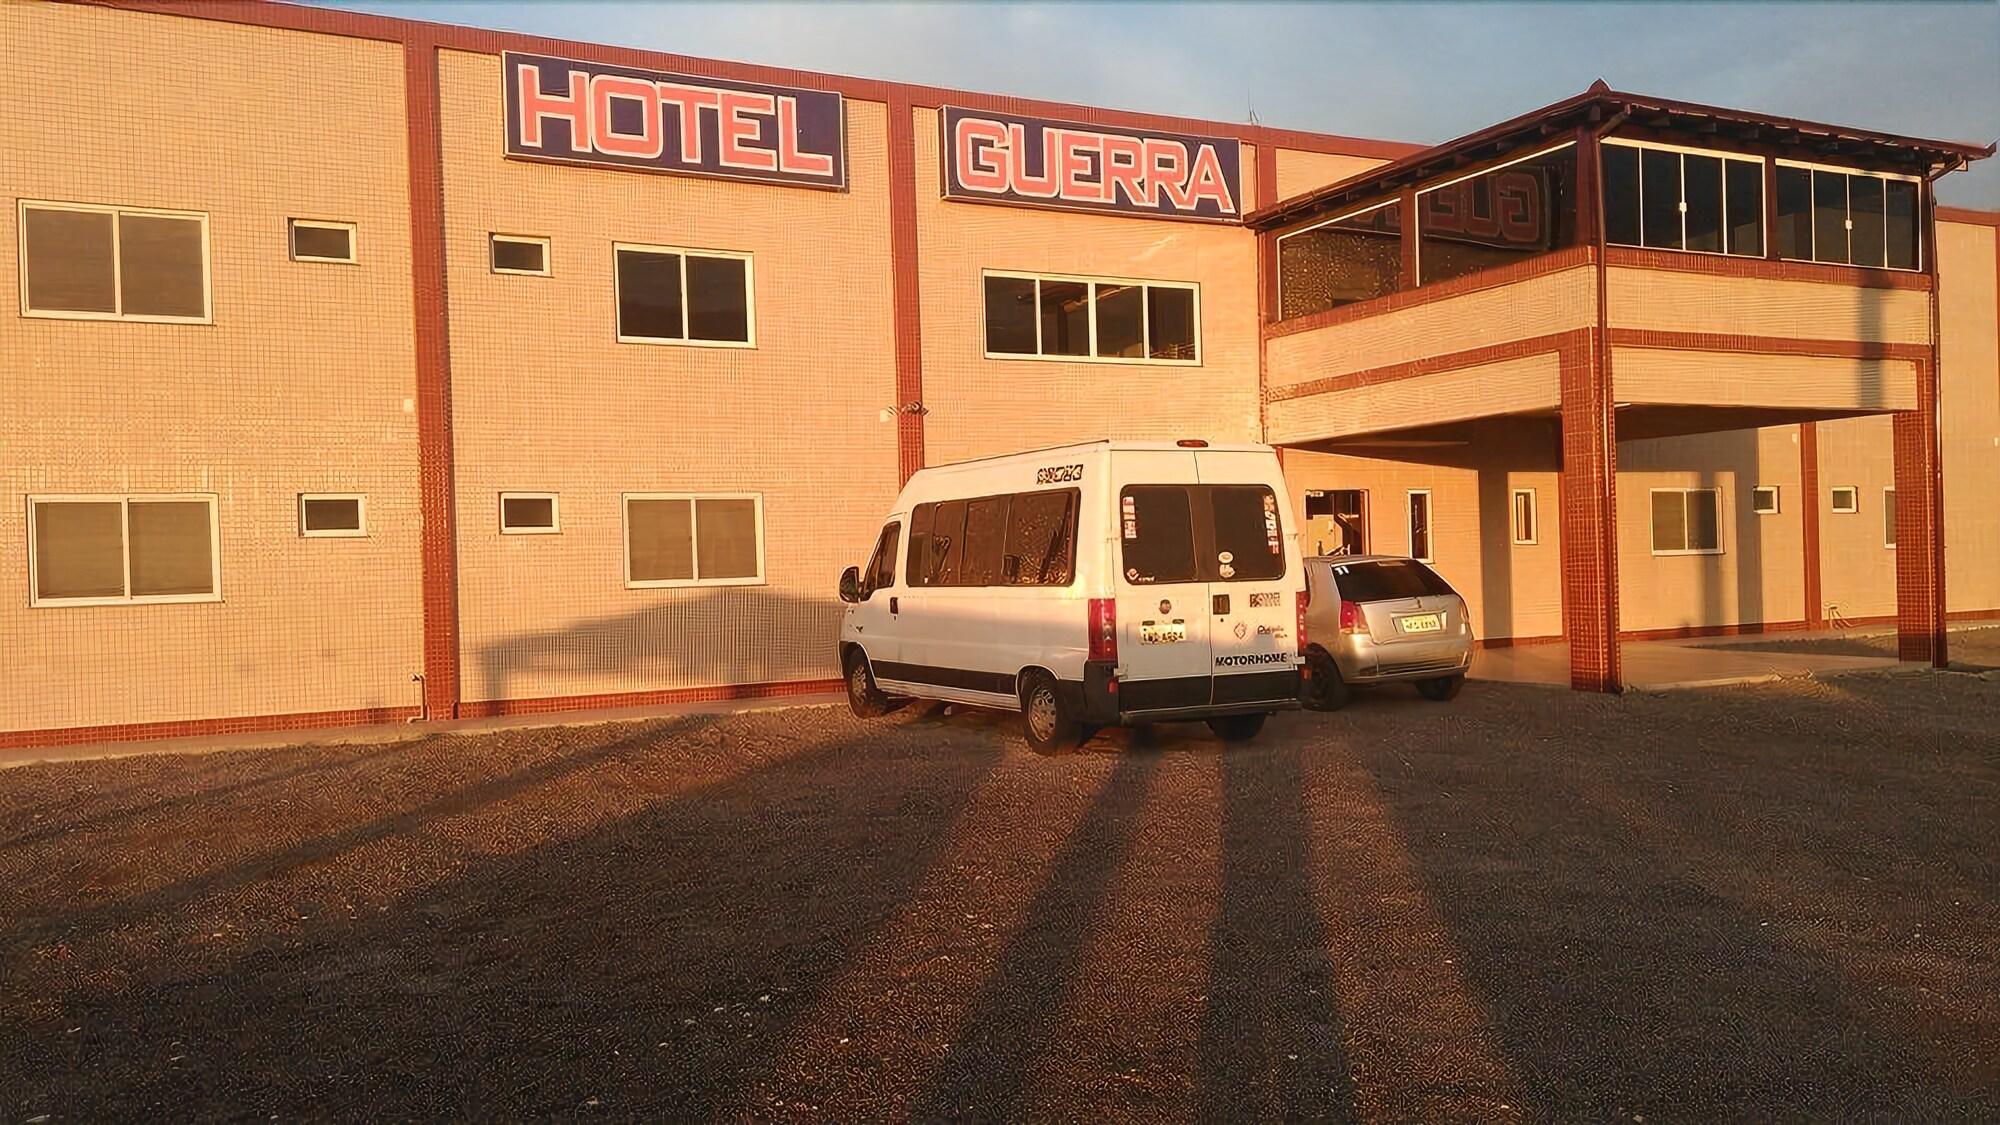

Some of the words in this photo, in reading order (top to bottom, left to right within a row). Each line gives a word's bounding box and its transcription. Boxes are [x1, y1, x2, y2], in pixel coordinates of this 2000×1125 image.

[517, 63, 834, 178] HOTEL
[954, 117, 1235, 214] GUERRA
[1214, 652, 1288, 667] MOTORHOME
